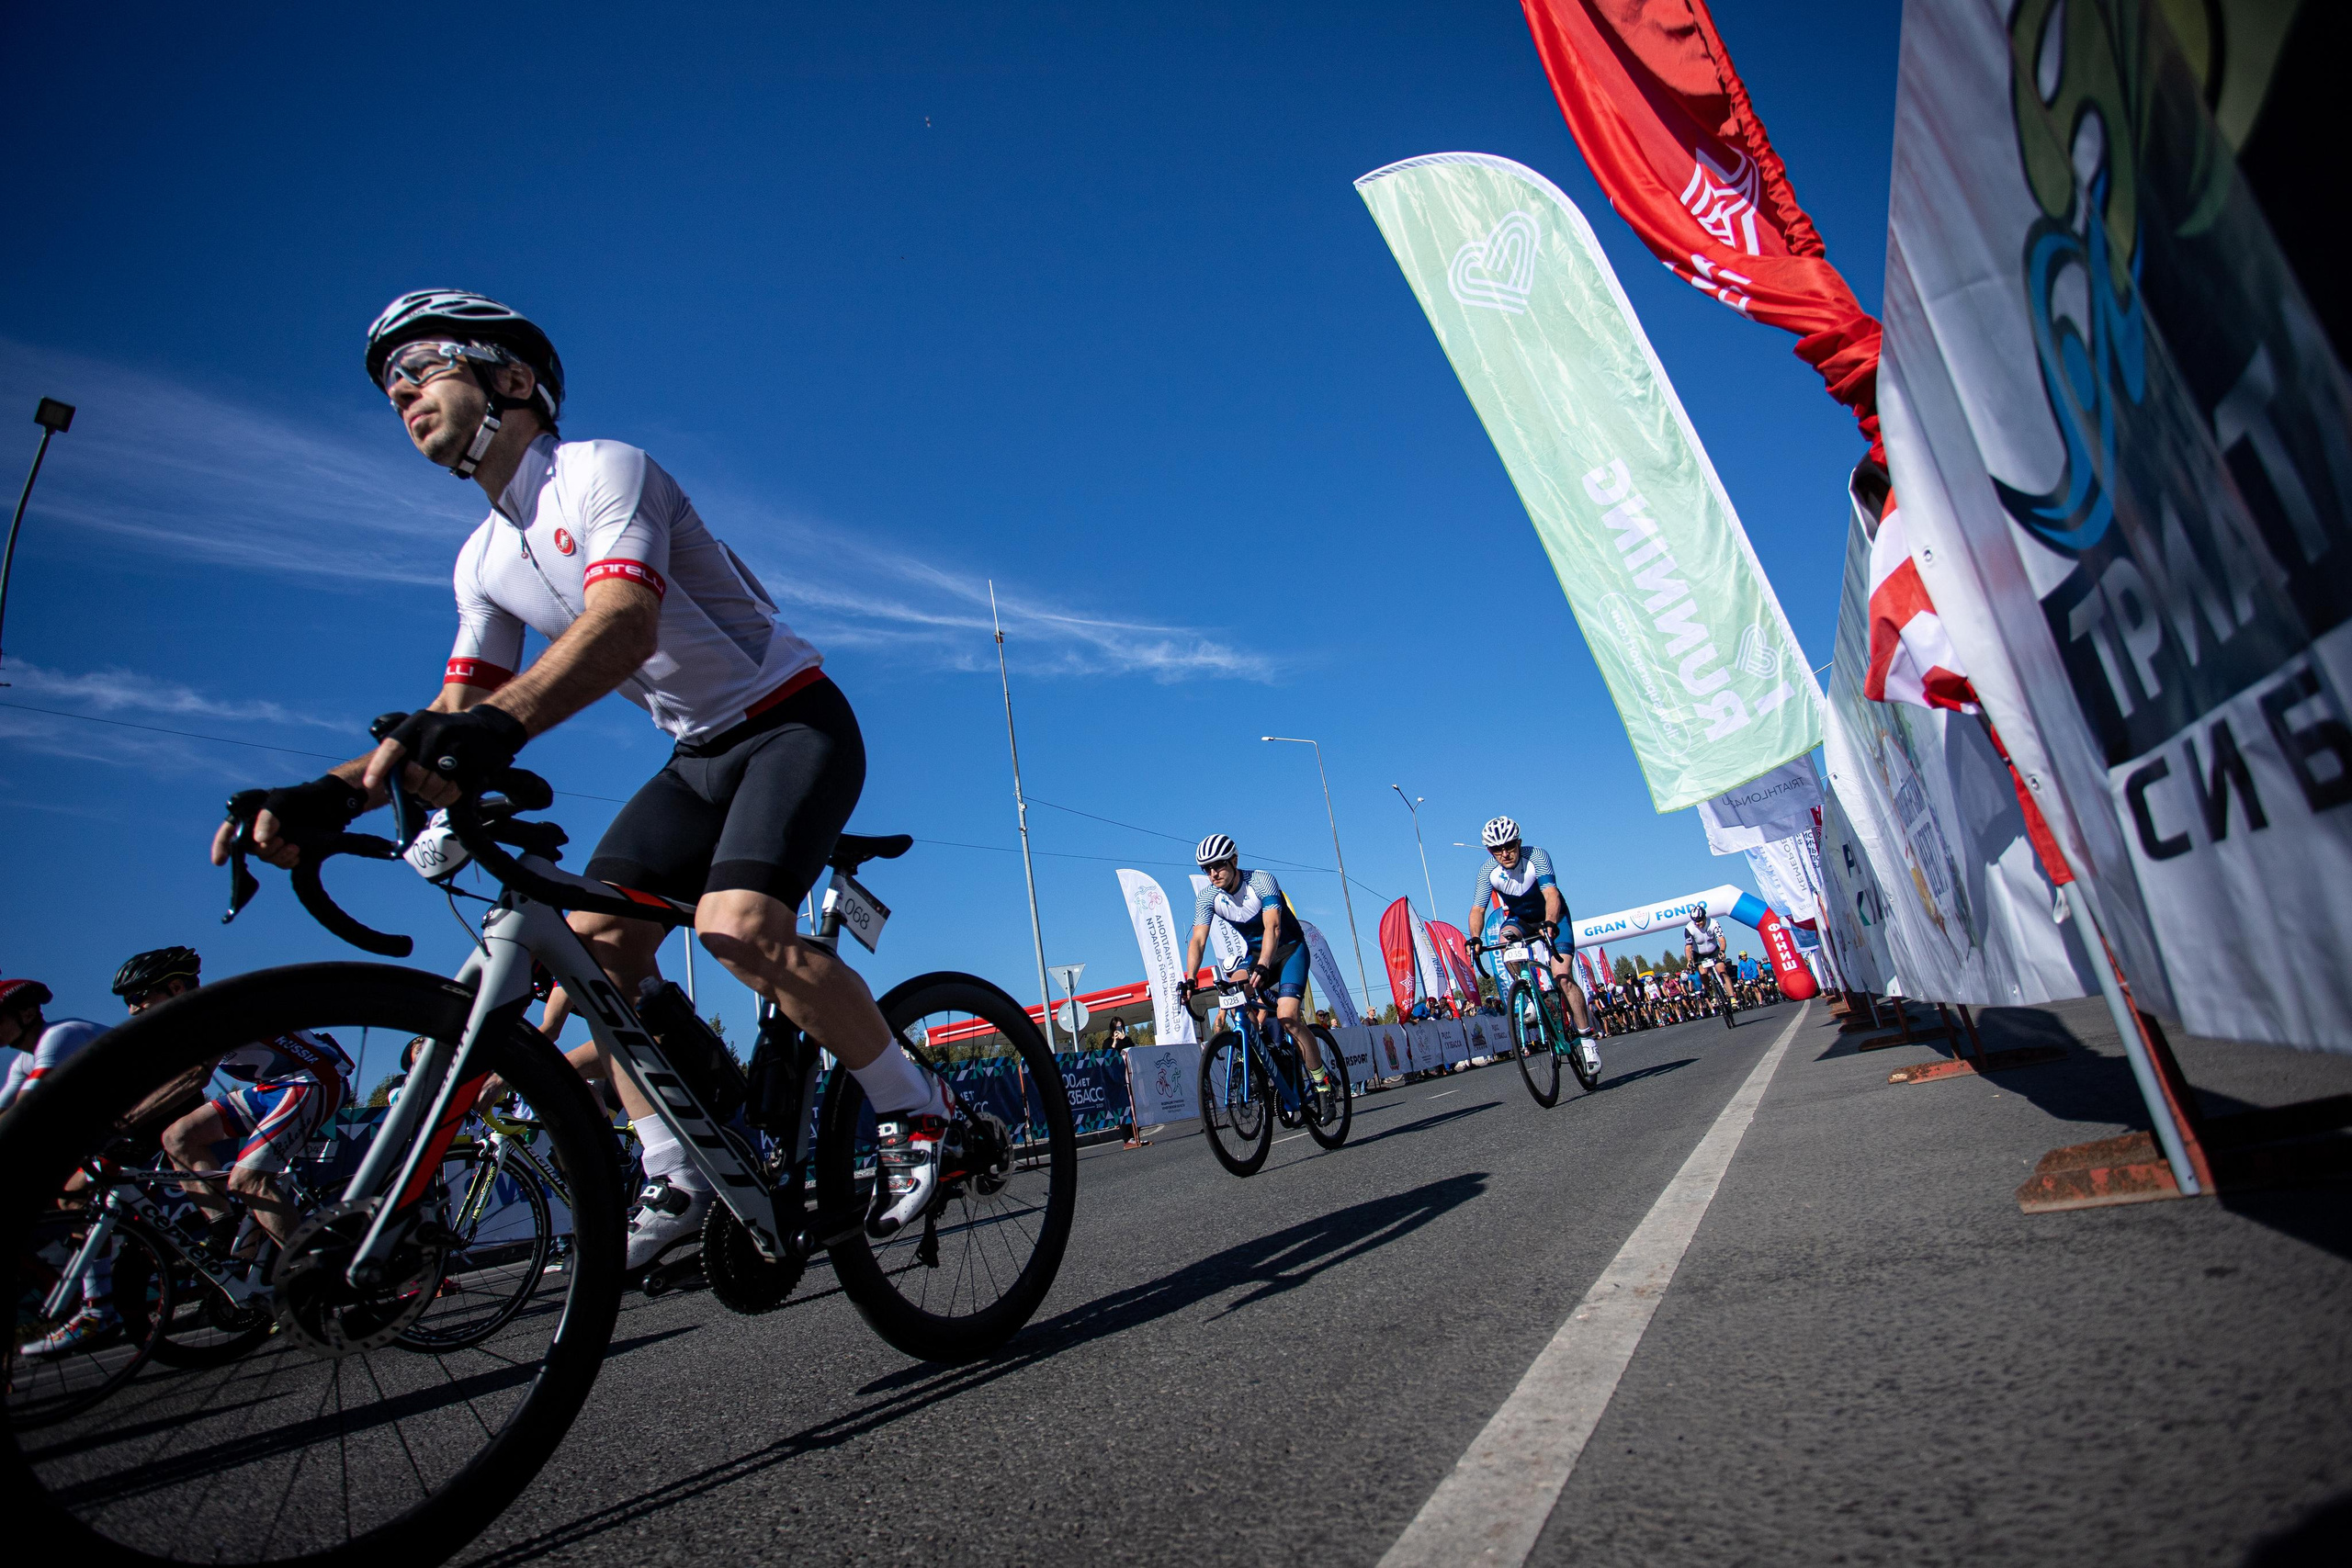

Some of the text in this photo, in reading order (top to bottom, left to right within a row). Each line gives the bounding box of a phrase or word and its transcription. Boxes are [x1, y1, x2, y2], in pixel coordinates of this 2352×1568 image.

[413, 840, 447, 868] 068
[845, 898, 870, 931] 068
[1584, 920, 1626, 937] GRAN
[1768, 923, 1798, 972] ФИНИШ
[1223, 997, 1239, 1007] 028
[274, 1035, 321, 1065] RUSSIA
[571, 976, 770, 1198] SCOTT
[1067, 1087, 1104, 1105] ЗБАСС
